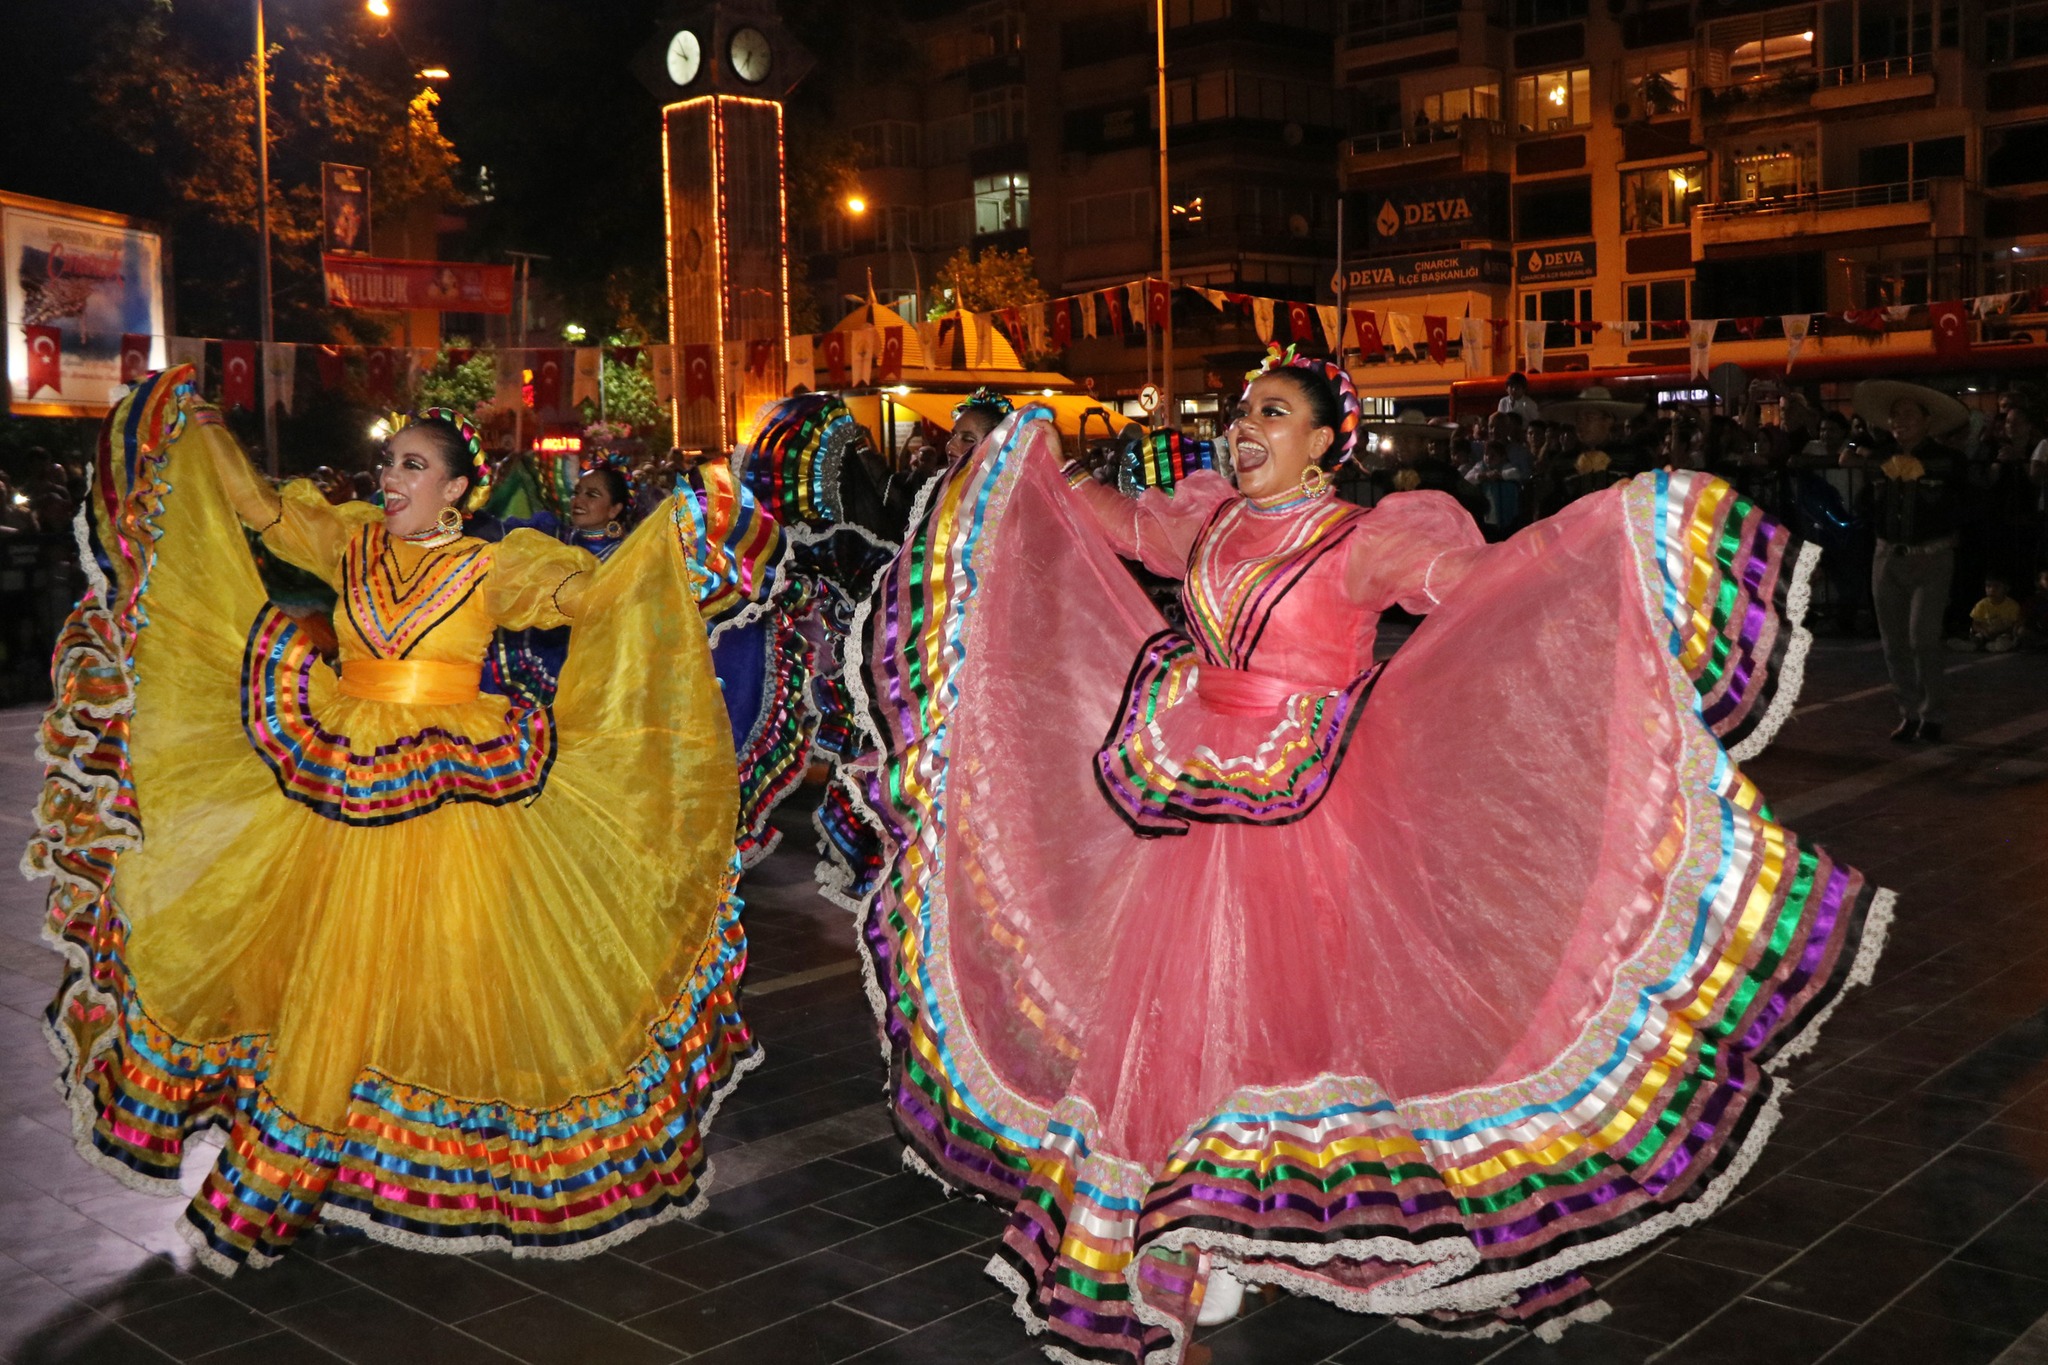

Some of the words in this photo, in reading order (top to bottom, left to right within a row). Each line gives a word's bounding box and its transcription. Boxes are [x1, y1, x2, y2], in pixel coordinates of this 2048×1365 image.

[1404, 198, 1472, 225] DEVA
[1415, 257, 1460, 273] ÇINARCIK
[1545, 251, 1584, 266] DEVA
[1349, 267, 1395, 287] DEVA
[1399, 272, 1419, 286] İLÇE
[1421, 266, 1479, 283] BAŞKANLIĞI
